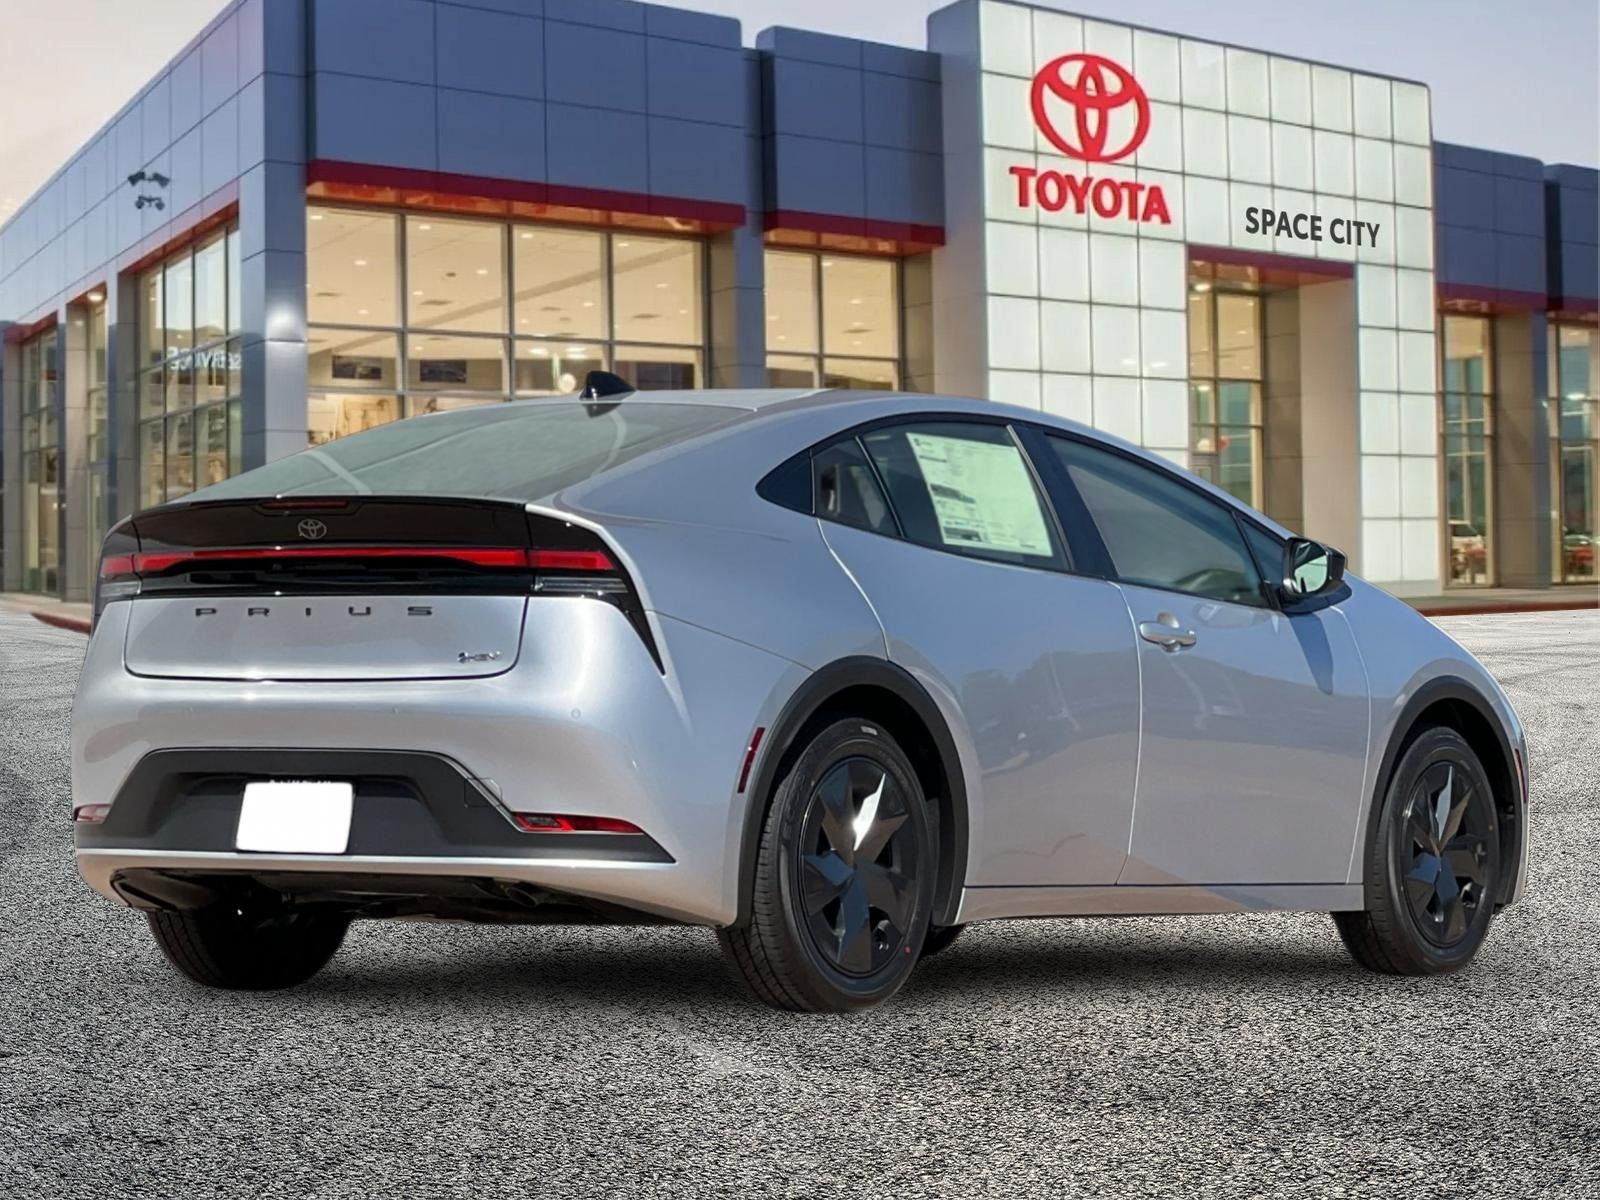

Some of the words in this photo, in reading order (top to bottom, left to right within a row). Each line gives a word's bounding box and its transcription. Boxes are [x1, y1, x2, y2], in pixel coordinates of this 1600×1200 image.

[1009, 166, 1171, 225] TOYOTA
[1245, 206, 1322, 242] SPACE
[1329, 217, 1381, 248] CITY
[195, 606, 433, 617] PRIUS
